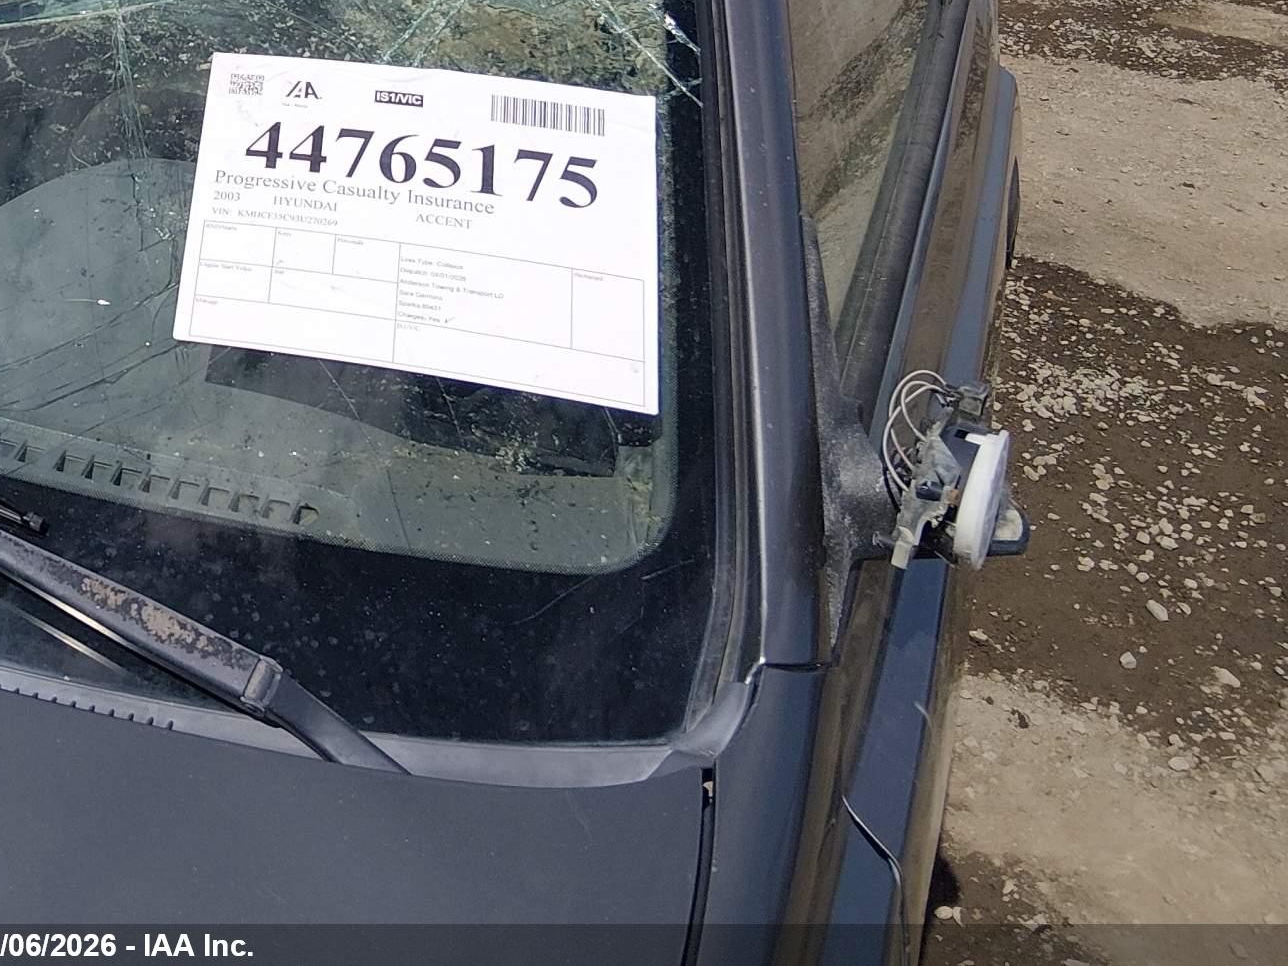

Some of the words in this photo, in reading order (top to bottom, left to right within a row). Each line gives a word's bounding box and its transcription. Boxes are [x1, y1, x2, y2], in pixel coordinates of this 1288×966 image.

[376, 91, 424, 106] IS1/VIC
[245, 122, 598, 209] 44765175
[213, 190, 241, 202] 2003
[273, 195, 338, 212] HYUNDAI
[416, 213, 472, 229] ACCENT
[215, 169, 316, 192] Progressive
[323, 179, 400, 205] Casualty
[408, 189, 494, 215] Insurance
